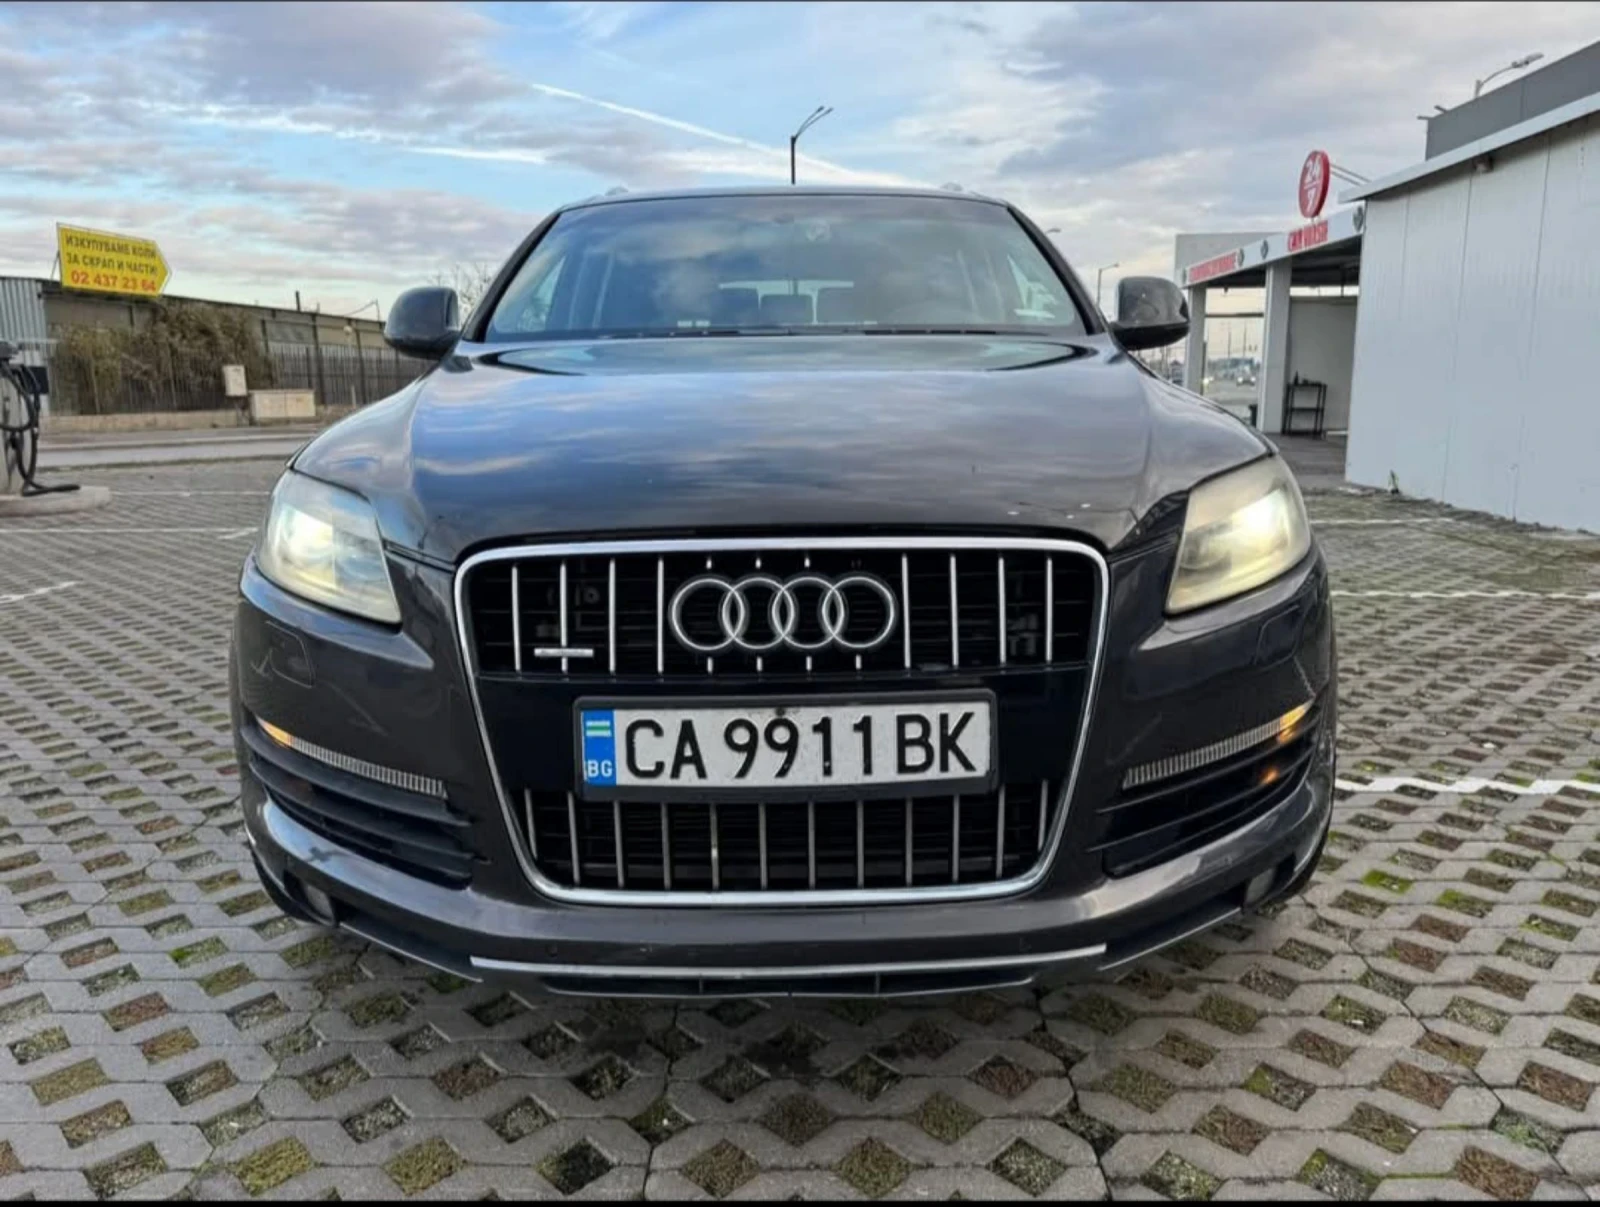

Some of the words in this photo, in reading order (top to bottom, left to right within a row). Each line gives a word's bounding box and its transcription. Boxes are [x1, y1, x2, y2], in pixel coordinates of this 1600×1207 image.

[66, 235, 130, 255] ИЗКУПУВАМЕ
[66, 252, 81, 264] ЗА
[82, 255, 115, 270] СКРАП
[117, 260, 125, 271] И
[126, 261, 158, 275] ЧАСТИ
[71, 270, 90, 285] 02
[93, 273, 119, 287] 437
[122, 276, 138, 291] 23
[626, 719, 708, 779] CA
[723, 715, 873, 779] 9911
[896, 711, 977, 775] BK
[587, 759, 613, 778] BG
